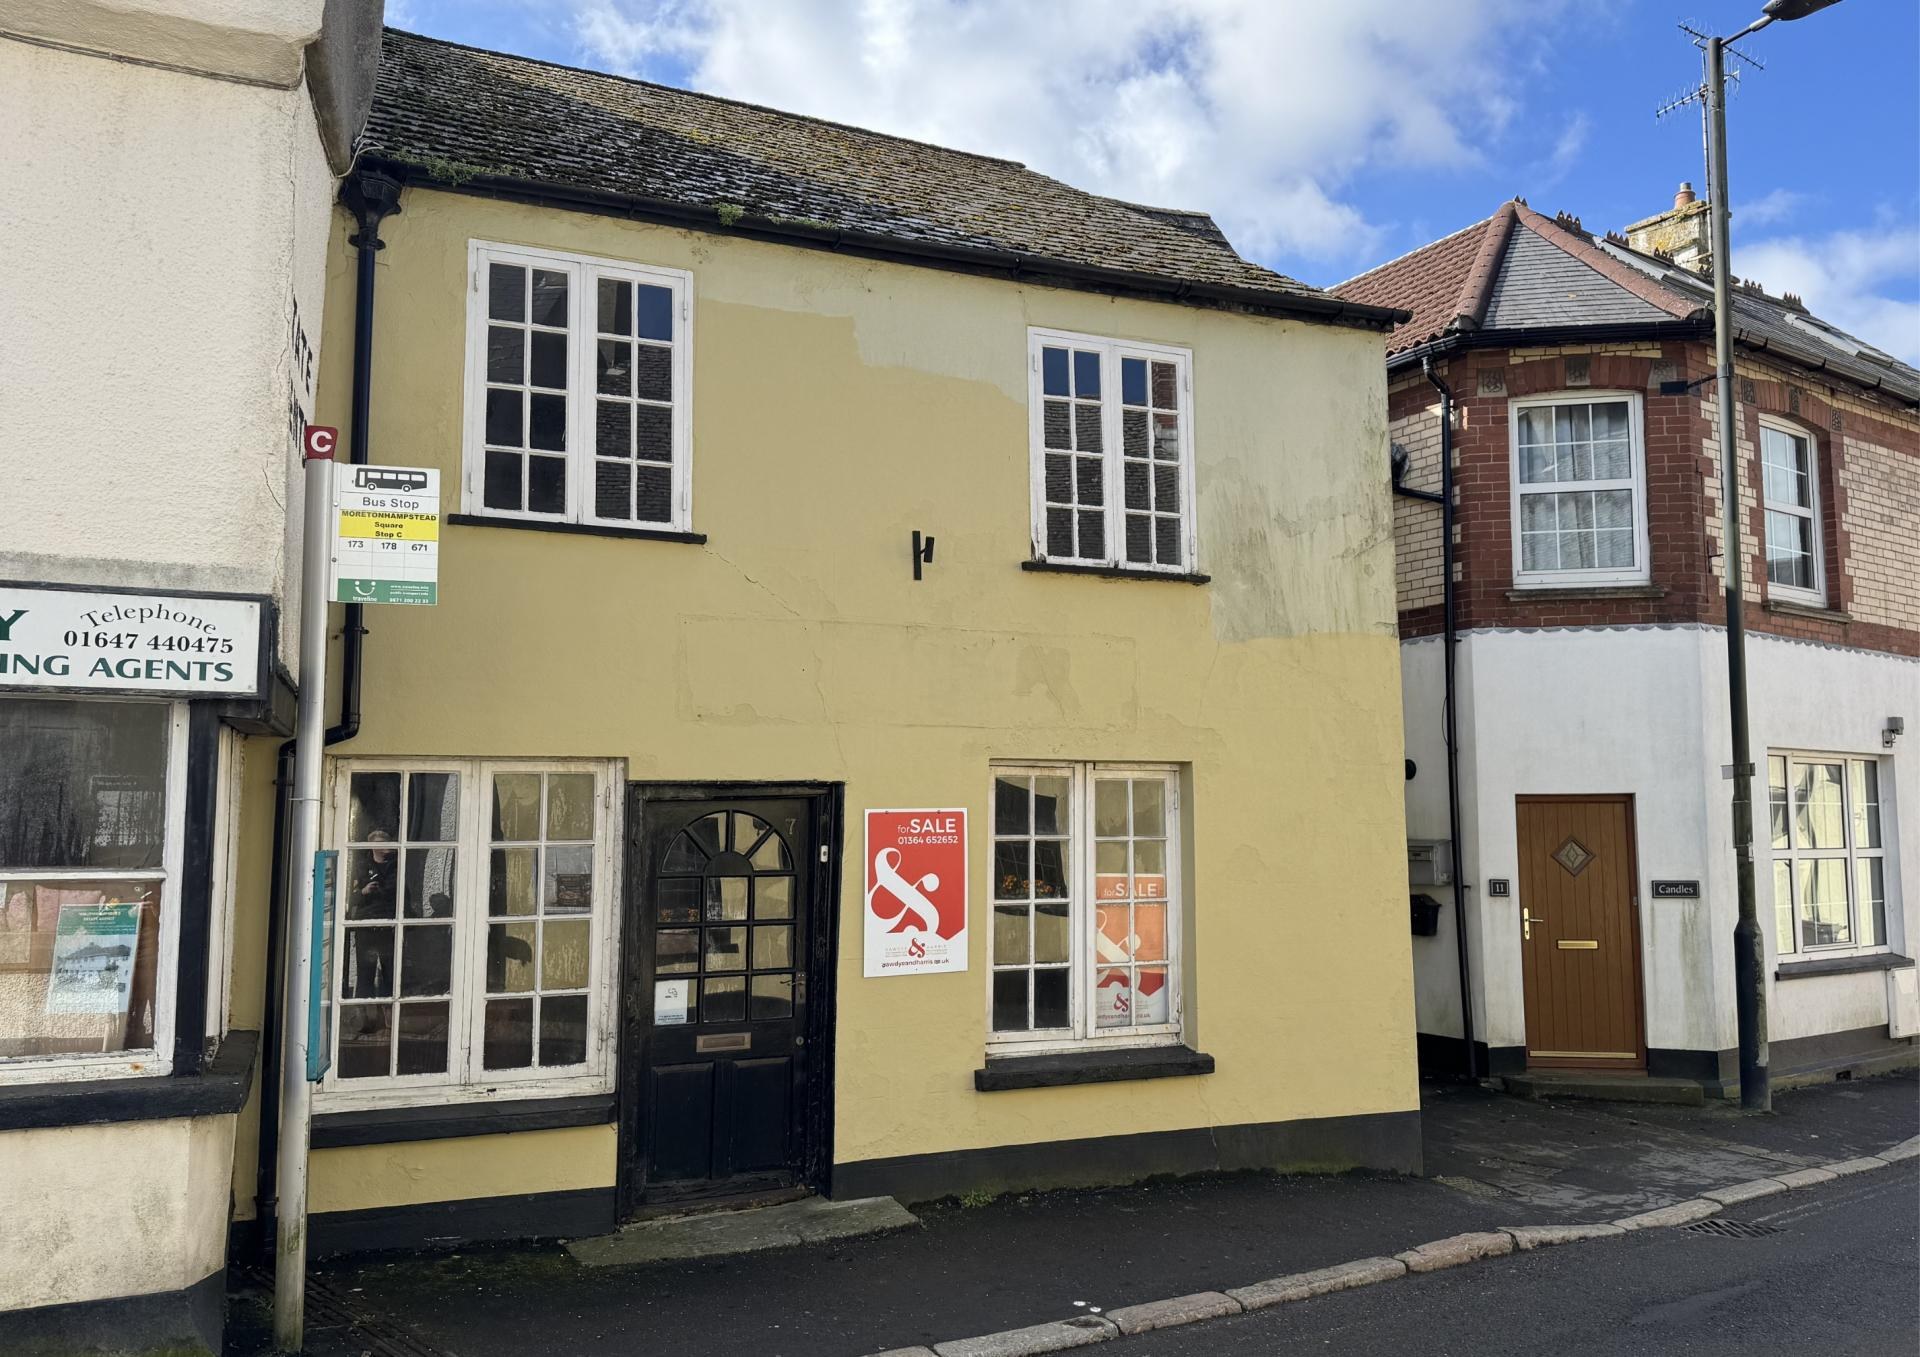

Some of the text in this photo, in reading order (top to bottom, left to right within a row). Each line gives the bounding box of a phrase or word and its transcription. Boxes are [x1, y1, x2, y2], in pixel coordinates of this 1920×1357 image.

[310, 431, 332, 453] C
[362, 496, 420, 511] Bus Stop
[341, 510, 437, 521] MORETONHAMPSTEAD
[374, 521, 404, 529] Square
[375, 530, 394, 538] Stop
[348, 540, 428, 552] 173 178 671
[79, 603, 217, 635] Telephone
[63, 630, 234, 654] 01647 440475
[88, 656, 234, 682] AGENTS
[785, 818, 796, 835] 7
[897, 818, 957, 834] for SALE
[897, 835, 959, 845] 01364 652652
[1496, 883, 1504, 892] 11
[1658, 885, 1694, 894] Candles
